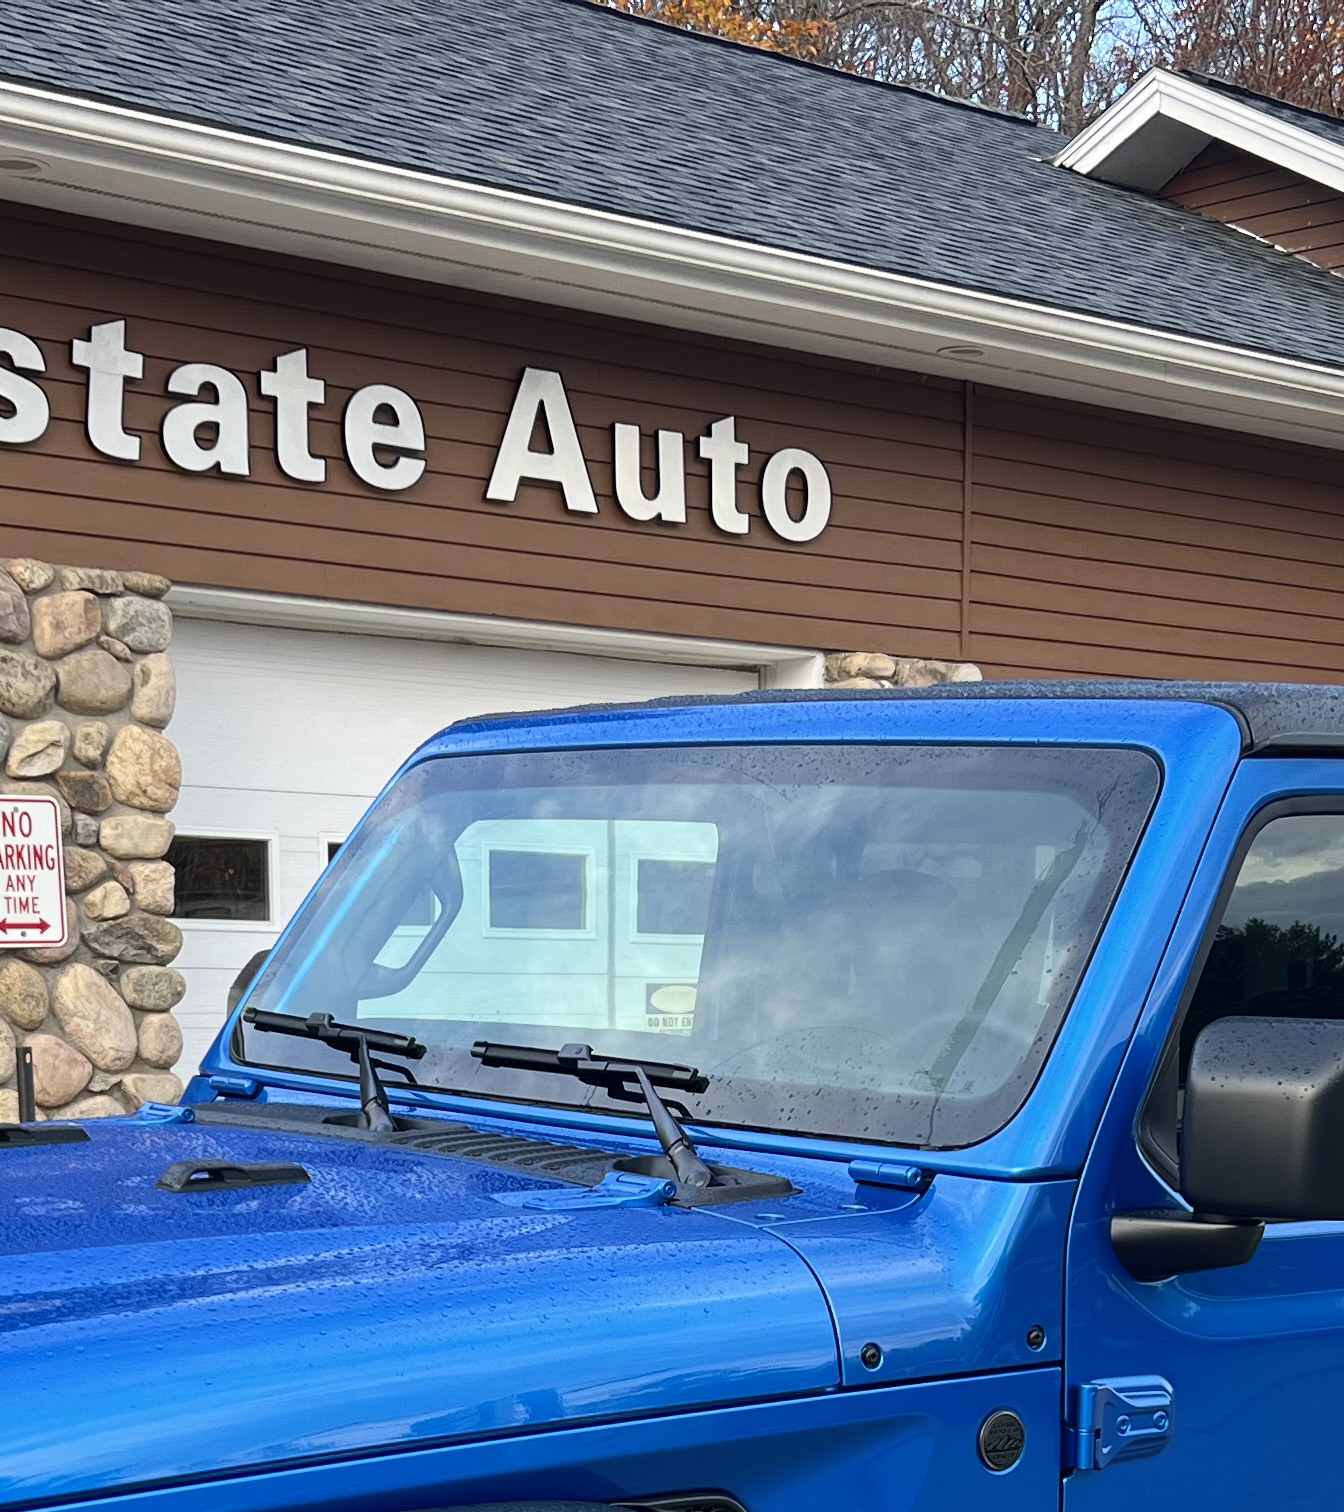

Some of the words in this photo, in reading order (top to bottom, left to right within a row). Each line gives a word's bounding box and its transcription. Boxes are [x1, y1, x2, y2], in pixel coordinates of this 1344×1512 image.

[485, 366, 833, 544] Auto
[1, 811, 32, 838] NO
[6, 874, 36, 892] ANY
[4, 896, 41, 914] TIME
[647, 1016, 659, 1027] DO
[661, 1016, 679, 1027] NOT
